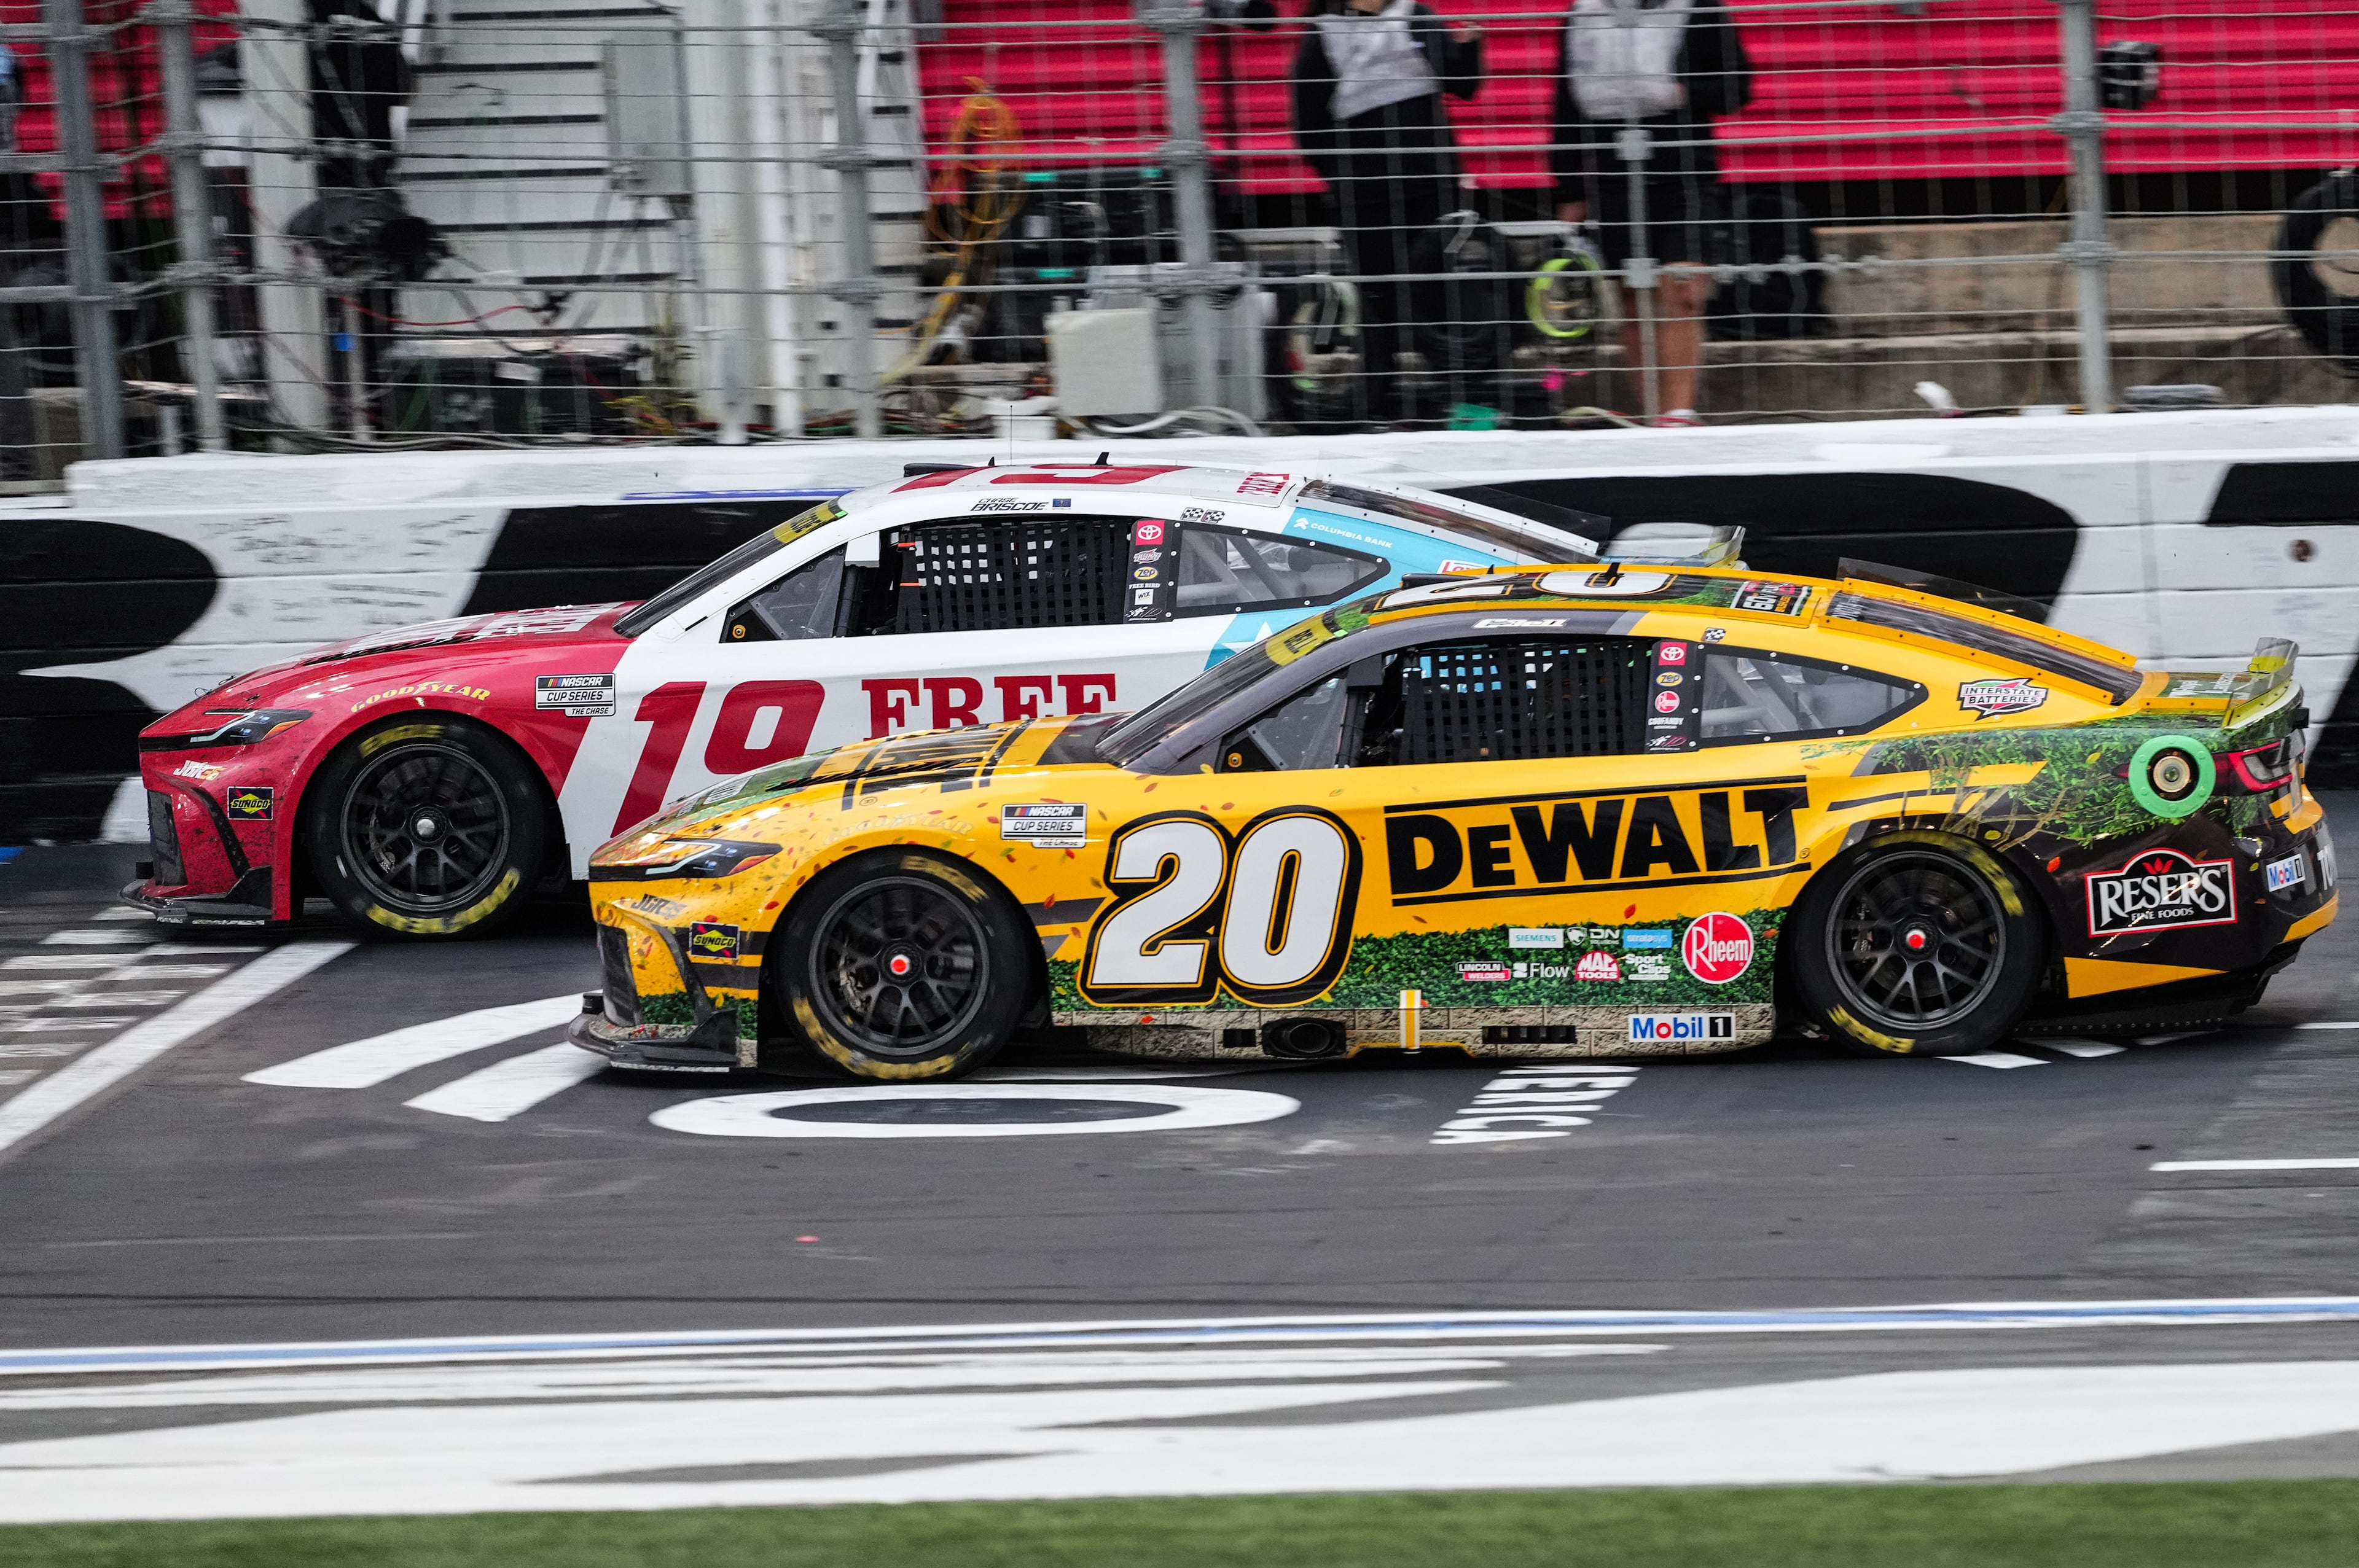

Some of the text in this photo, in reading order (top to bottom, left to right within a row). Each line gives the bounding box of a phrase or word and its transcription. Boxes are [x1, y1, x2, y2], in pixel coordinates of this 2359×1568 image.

[970, 502, 1049, 511] BRISCOE
[1310, 523, 1393, 548] COLUMBIA BANK
[561, 676, 603, 687] NASCAR
[351, 681, 491, 712] GOODYEAR
[547, 691, 603, 701] CUP SERIES
[1965, 687, 2041, 696] INTERSTATE
[1968, 695, 2037, 704] BATTERIES
[232, 799, 270, 809] SUNOCO
[1028, 806, 1074, 817] NASCAR
[1014, 821, 1074, 831] CUP SERIES
[2268, 859, 2296, 889] Mobil
[1086, 812, 1352, 990] 20
[2098, 867, 2227, 927] RESER'S
[2131, 907, 2195, 921] FINE FOODS
[1590, 928, 1621, 939] DN
[695, 935, 735, 946] SUNOCO
[1691, 915, 1750, 972] Rheem
[1578, 951, 1618, 972] MAC
[1625, 953, 1664, 966] Sport
[1458, 963, 1502, 972] LINCOLN
[1530, 962, 1570, 978] Flow
[1637, 963, 1672, 975] Clips
[1632, 1016, 1703, 1040] Mobil
